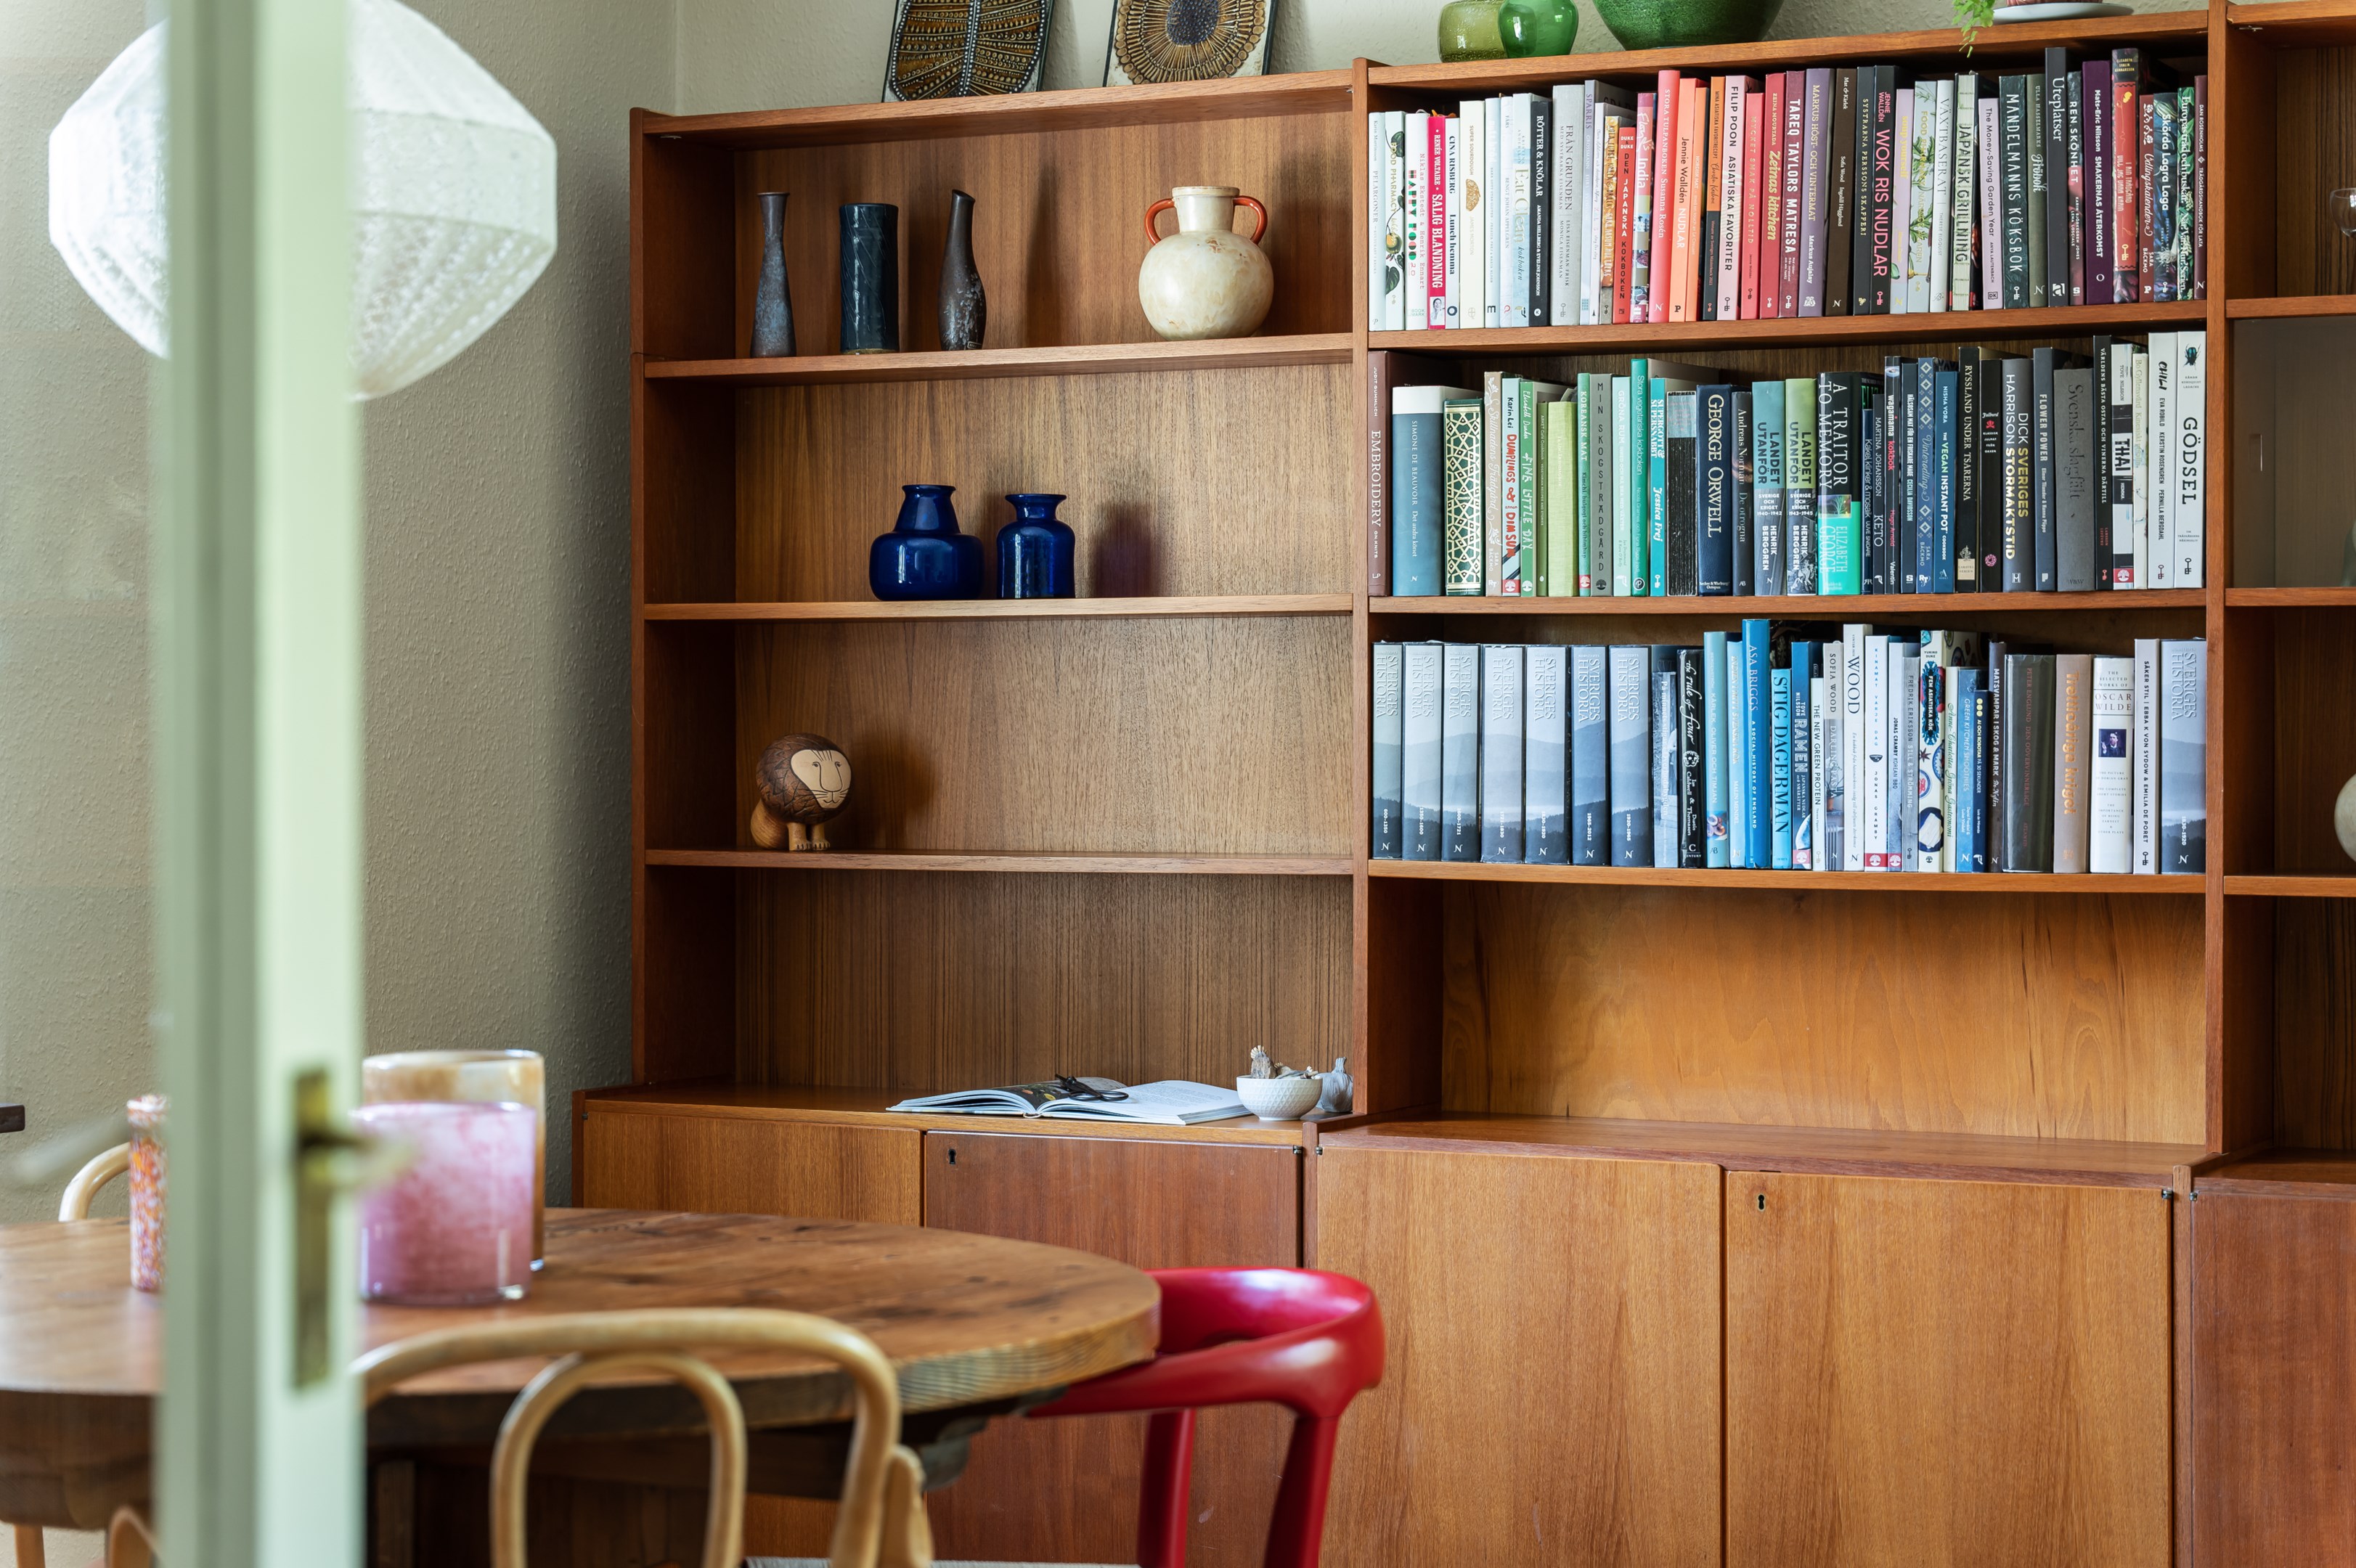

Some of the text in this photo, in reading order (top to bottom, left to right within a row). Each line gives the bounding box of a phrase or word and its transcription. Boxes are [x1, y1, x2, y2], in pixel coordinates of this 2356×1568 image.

[1729, 86, 1739, 147] FILIP POON
[1788, 99, 1800, 136] TAREQ
[1810, 123, 1819, 148] HÖST-
[2048, 78, 2065, 142] Uteplatser
[1565, 126, 1574, 211] FRÅN GRUNDEN
[1679, 137, 1689, 203] Jennie Walldén
[1787, 143, 1799, 192] TAYLORS
[1936, 99, 1951, 195] VÄXTBASERAT
[1984, 126, 1994, 183] Money-Saving
[2160, 114, 2171, 211] Skörda Lagra Laga
[1767, 151, 1780, 240] Zeinas kitchen
[1808, 171, 1817, 221] VINTERMAT
[1873, 129, 1890, 276] WOK RIS NUDLAR
[1956, 125, 1971, 261] JAPANSK GRILLNING
[2006, 94, 2023, 271] MANDELMANNS KÖKSBOK
[1432, 194, 1443, 288] SALIG BLANDNING
[1658, 214, 1667, 238] Rosén
[1676, 208, 1686, 248] NUDLAR
[1725, 214, 1734, 270] FAVORITER
[1785, 199, 1798, 253] MATRESA
[2158, 362, 2167, 390] CHILI
[1635, 396, 1644, 437] vegetariska
[1819, 381, 1833, 489] TO MEMORY
[1833, 383, 1848, 485] A TRAITOR
[2005, 375, 2015, 444] HARRISON
[2018, 413, 2028, 444] DICK
[1412, 454, 1417, 465] DE
[1708, 394, 1724, 537] GEORGE ORWELL
[1738, 409, 1747, 484] Andreas Norman
[1758, 422, 1769, 484] UTANFÖR
[1770, 433, 1780, 484] LANDET
[1790, 422, 1801, 483] UTANFÖR
[1801, 432, 1811, 484] LANDET
[2064, 384, 2085, 499] Svenska slagfält
[2115, 438, 2130, 471] THAI
[2182, 417, 2201, 505] GÖDSEL
[1371, 430, 1381, 526] EMBROIDERY
[2005, 448, 2015, 559] STORMAKTSTID
[2018, 448, 2028, 518] SVERIGES
[1653, 487, 1663, 542] Jessica Frej
[1737, 493, 1748, 542] De otrogna
[1875, 515, 1883, 546] KETO
[1820, 526, 1835, 573] GEORGE
[1836, 526, 1847, 572] ELIZABETH
[1376, 656, 1387, 718] HISTORIA
[1387, 656, 1398, 716] SVERIGES
[1411, 657, 1423, 719] HISTORIA
[1423, 657, 1435, 717] SVERIGES
[1448, 657, 1460, 719] HISTORIA
[1461, 657, 1472, 717] SVERIGES
[1493, 658, 1503, 721] HISTORIA
[1503, 658, 1514, 719] SVERIGES
[1534, 658, 1545, 721] HISTORIA
[1545, 658, 1556, 719] SVERIGES
[1578, 659, 1589, 722] HISTORIA
[1589, 659, 1601, 720] SVERIGES
[1618, 659, 1629, 722] HISTORIA
[1629, 659, 1639, 720] SVERIGES
[1679, 661, 1702, 744] the rule of four
[1748, 645, 1757, 711] ASA BRIGGS
[1848, 656, 1859, 714] WOOD
[2172, 653, 2185, 720] HISTORIA
[2185, 653, 2196, 718] SVERIGES
[1773, 677, 1788, 834] STIG DAGERMAN
[1794, 719, 1807, 772] RAMEN
[1946, 703, 1956, 837] Anne-Charlottes Gröna Gastronomi
[2063, 671, 2079, 814] Trettioåriga kriget
